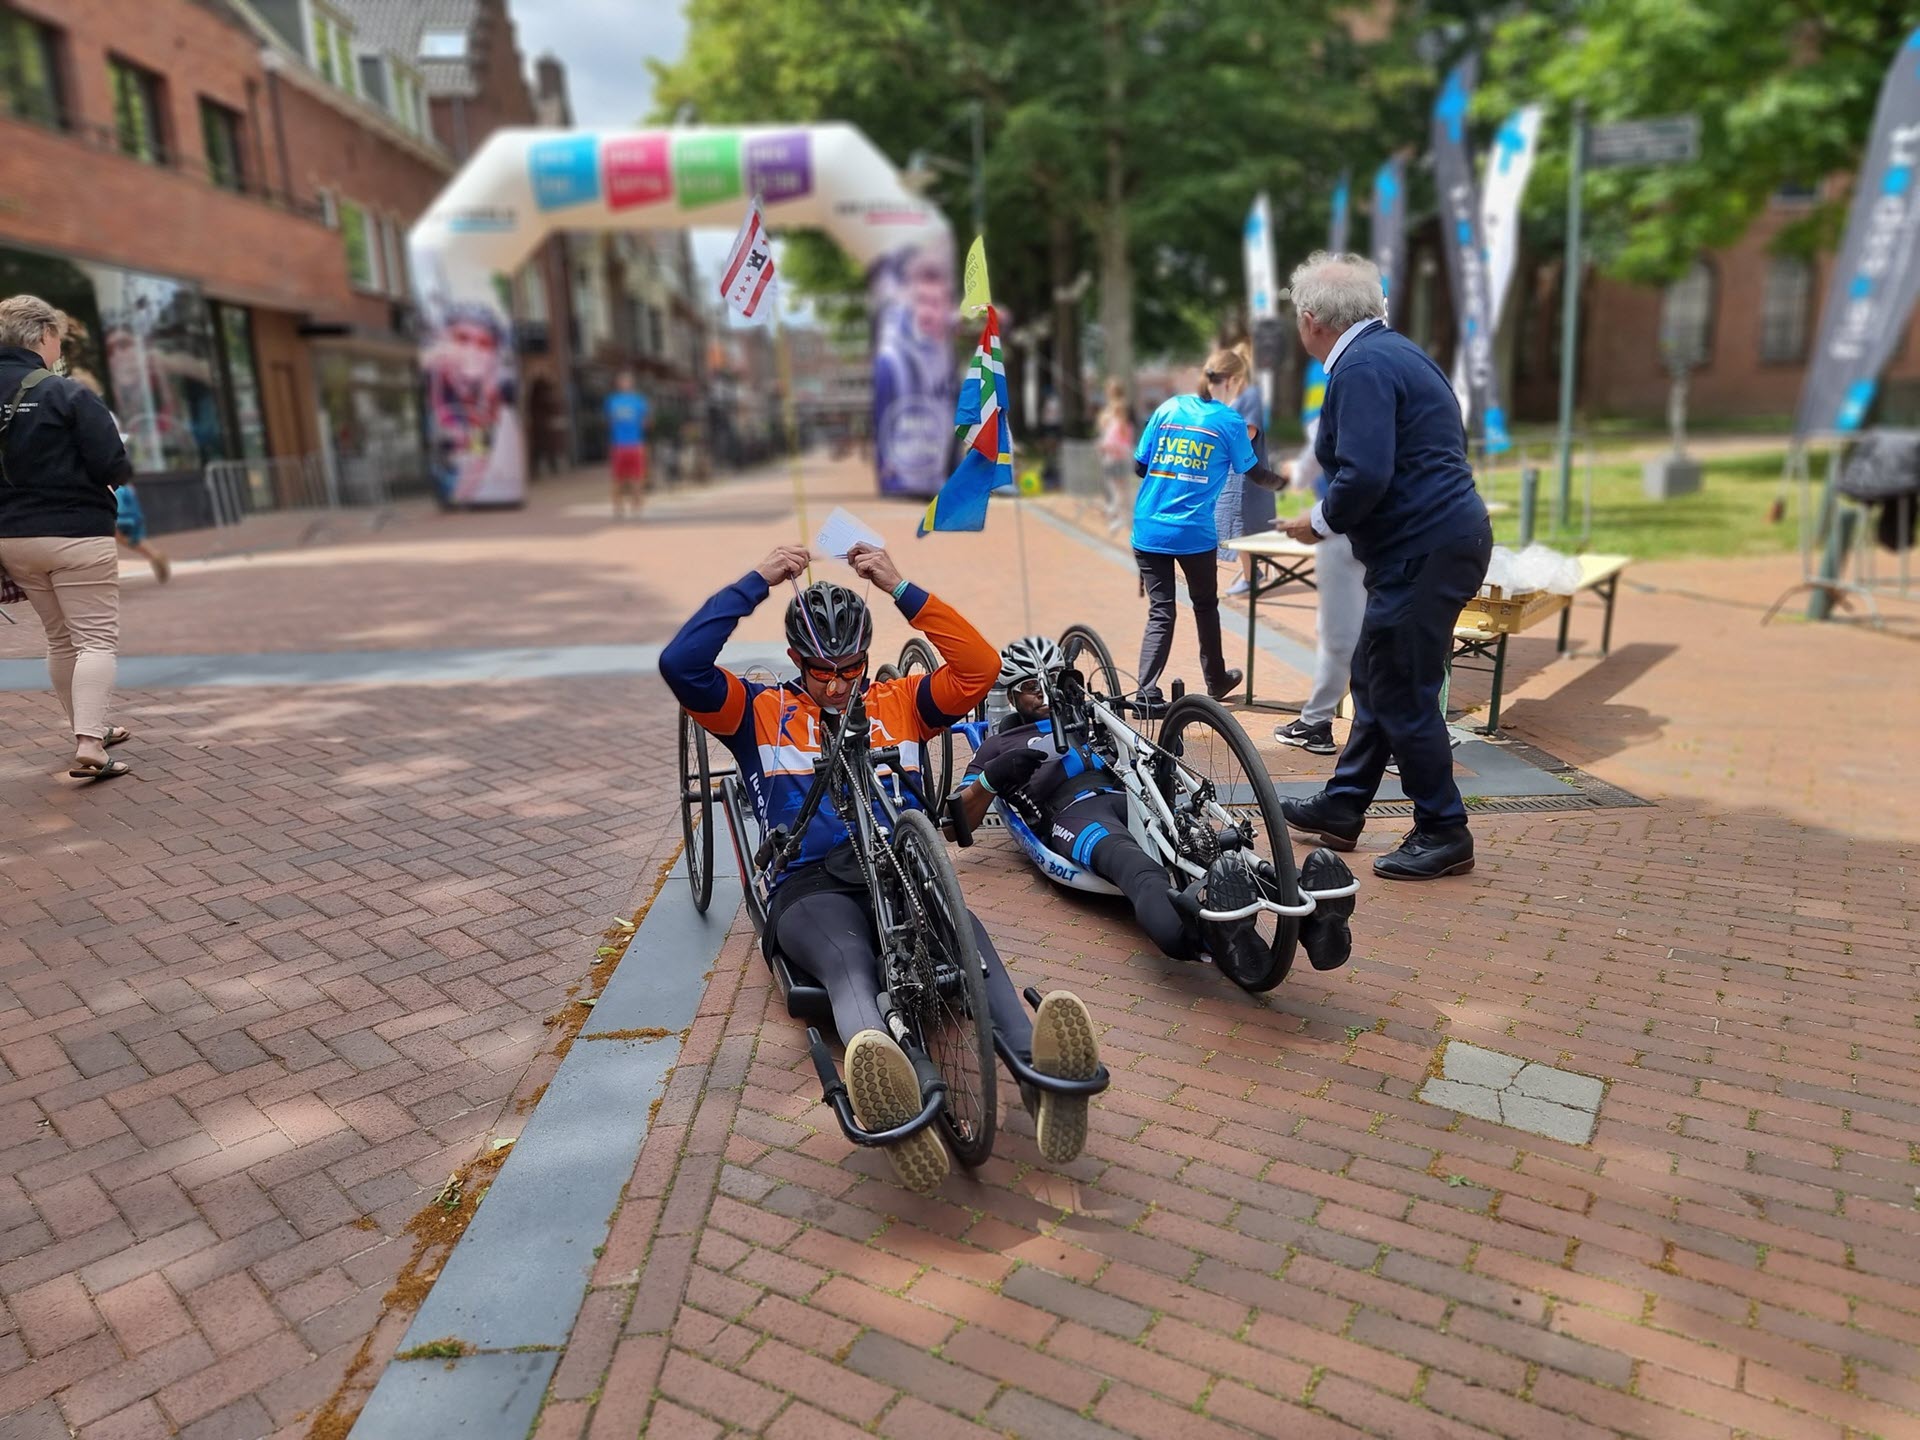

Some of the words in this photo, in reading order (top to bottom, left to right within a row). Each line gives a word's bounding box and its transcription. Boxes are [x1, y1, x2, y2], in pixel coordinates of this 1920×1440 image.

[1158, 436, 1215, 459] EVENT
[1152, 453, 1208, 471] SUPPORT
[1048, 860, 1079, 881] BOLT
